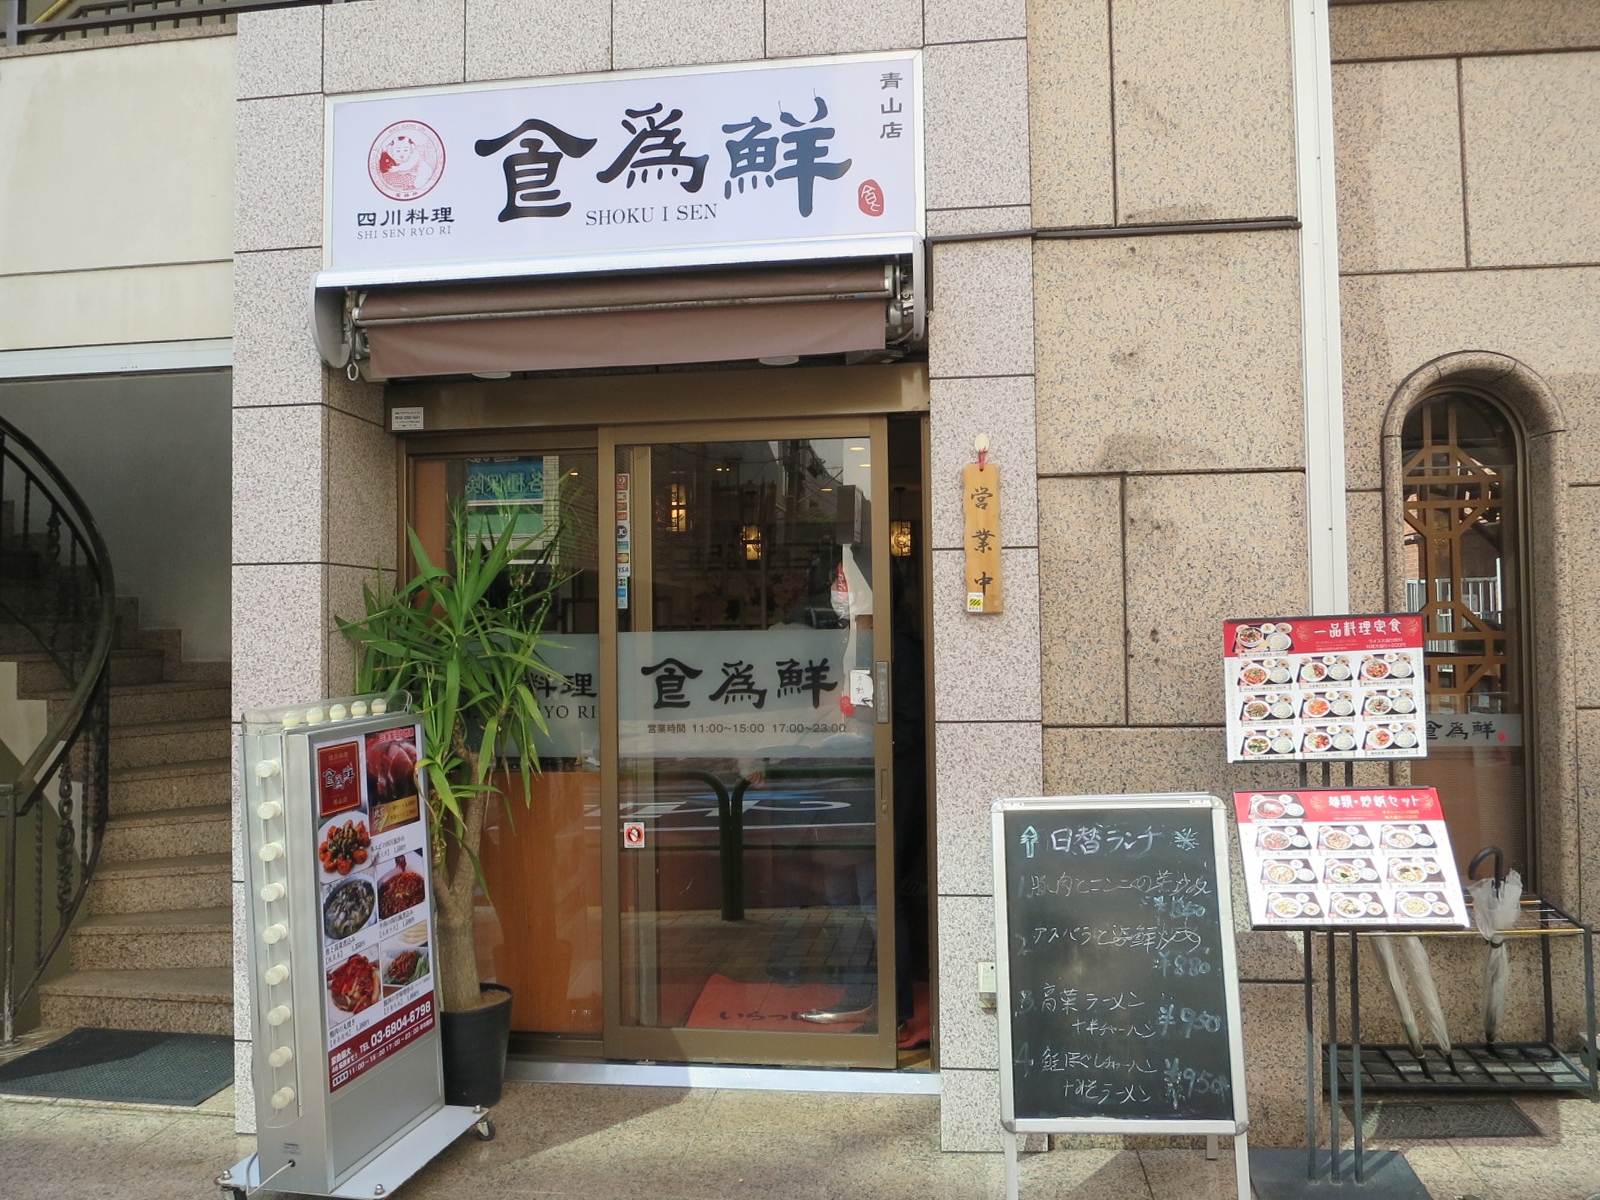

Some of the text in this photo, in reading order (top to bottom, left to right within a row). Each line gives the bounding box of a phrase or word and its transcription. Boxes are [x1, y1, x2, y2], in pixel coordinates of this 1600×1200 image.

[879, 71, 903, 140] 青山店
[357, 206, 455, 227] 四川料理
[585, 203, 718, 227] SHOKU I SEN
[357, 225, 451, 240] SHI SEN RYO RI
[970, 486, 996, 597] 営業中
[1314, 618, 1402, 638] 一品料理定食
[578, 705, 596, 719] RI
[647, 723, 846, 734] 営業時間 11:00~15:00 17:00~23:00
[1051, 825, 1163, 856] 日替ランチ
[1158, 950, 1211, 977] ¥880
[1041, 983, 1145, 1015] 高菜ラーメン
[359, 1042, 370, 1053] TEL
[370, 1001, 431, 1047] 03-6804-6798
